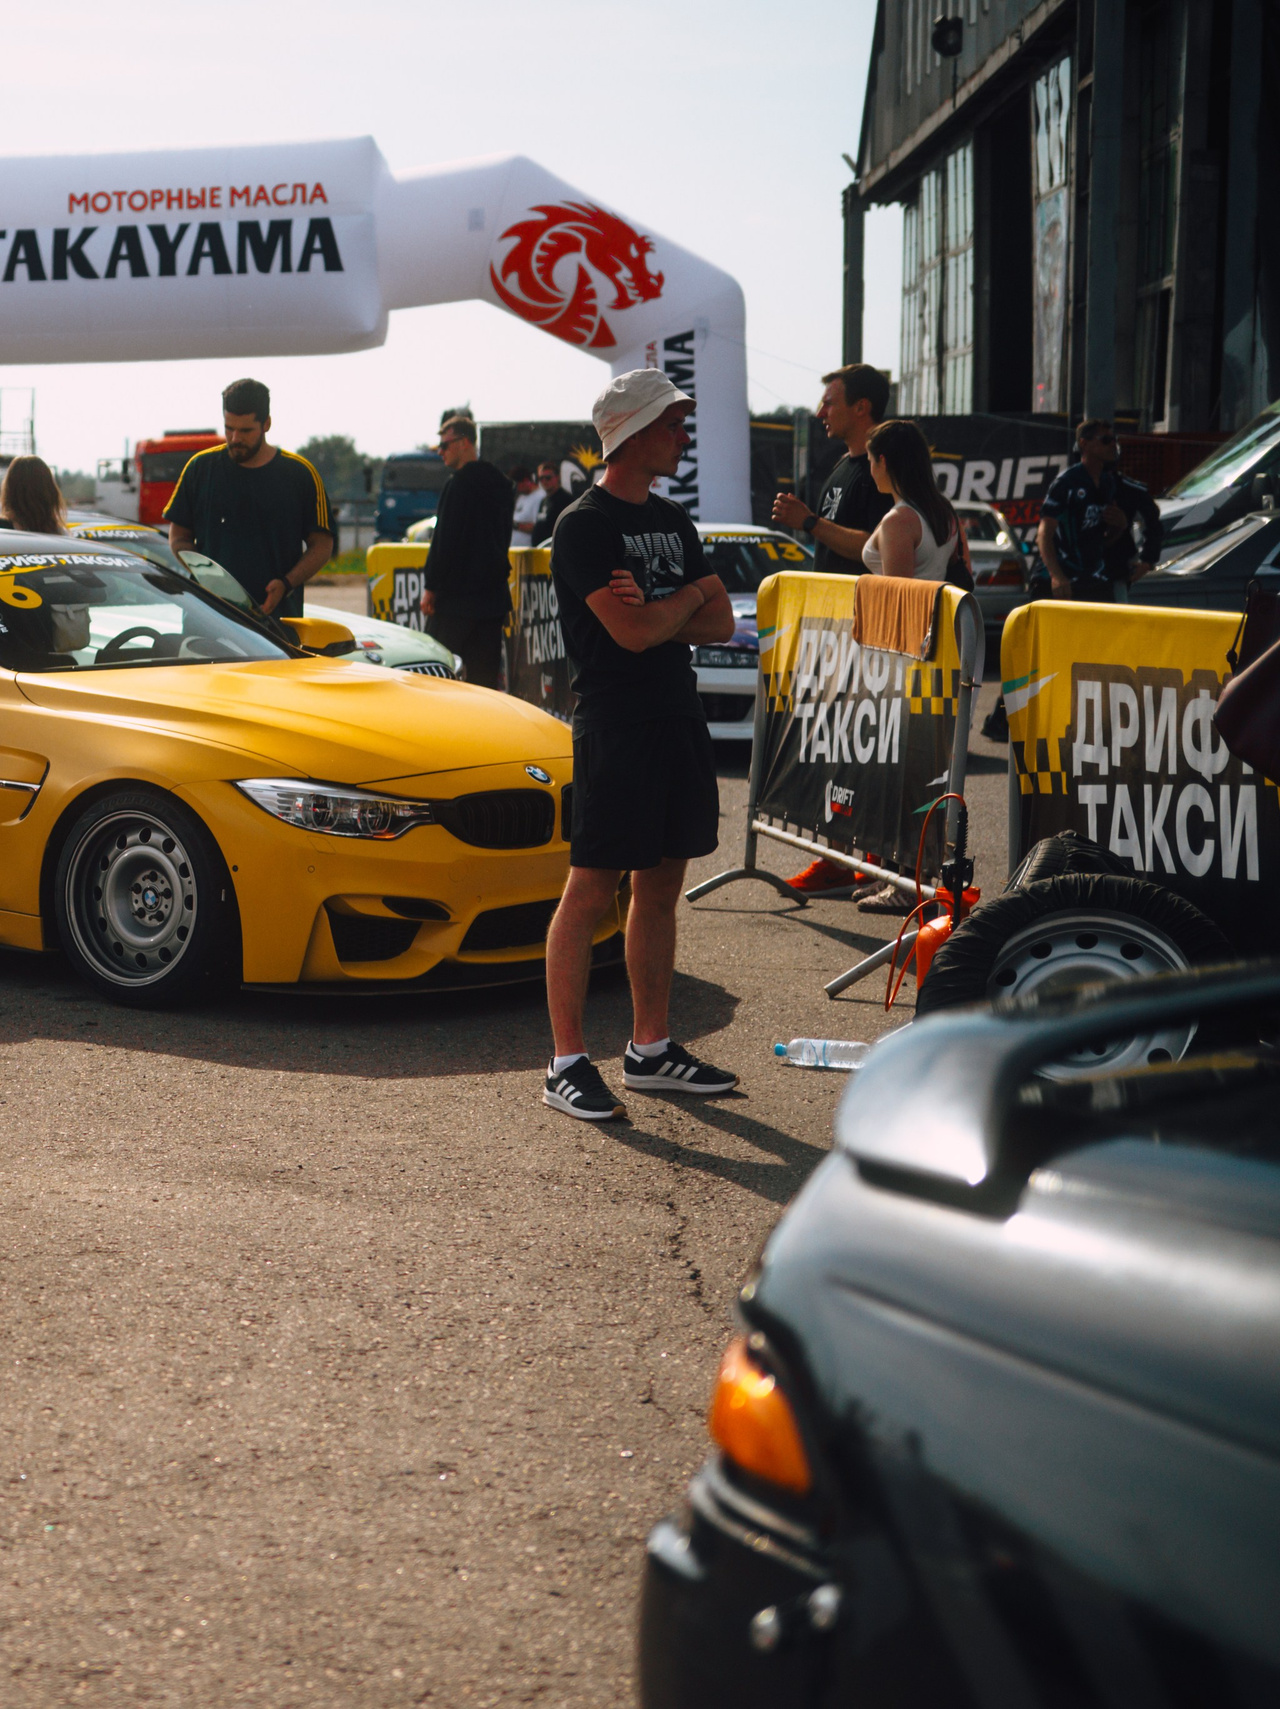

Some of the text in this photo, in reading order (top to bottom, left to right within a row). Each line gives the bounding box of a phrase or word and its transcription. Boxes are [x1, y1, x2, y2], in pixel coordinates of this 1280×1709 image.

[68, 182, 328, 214] МОТОРНЫЕ МАСЛА
[56, 554, 130, 568] ТАКСИ
[758, 542, 806, 561] 13
[794, 697, 902, 764] ТАКСИ
[1072, 680, 1254, 783] ДРИФ
[832, 785, 855, 807] DRIFT
[1077, 783, 1260, 882] ТАКСИ
